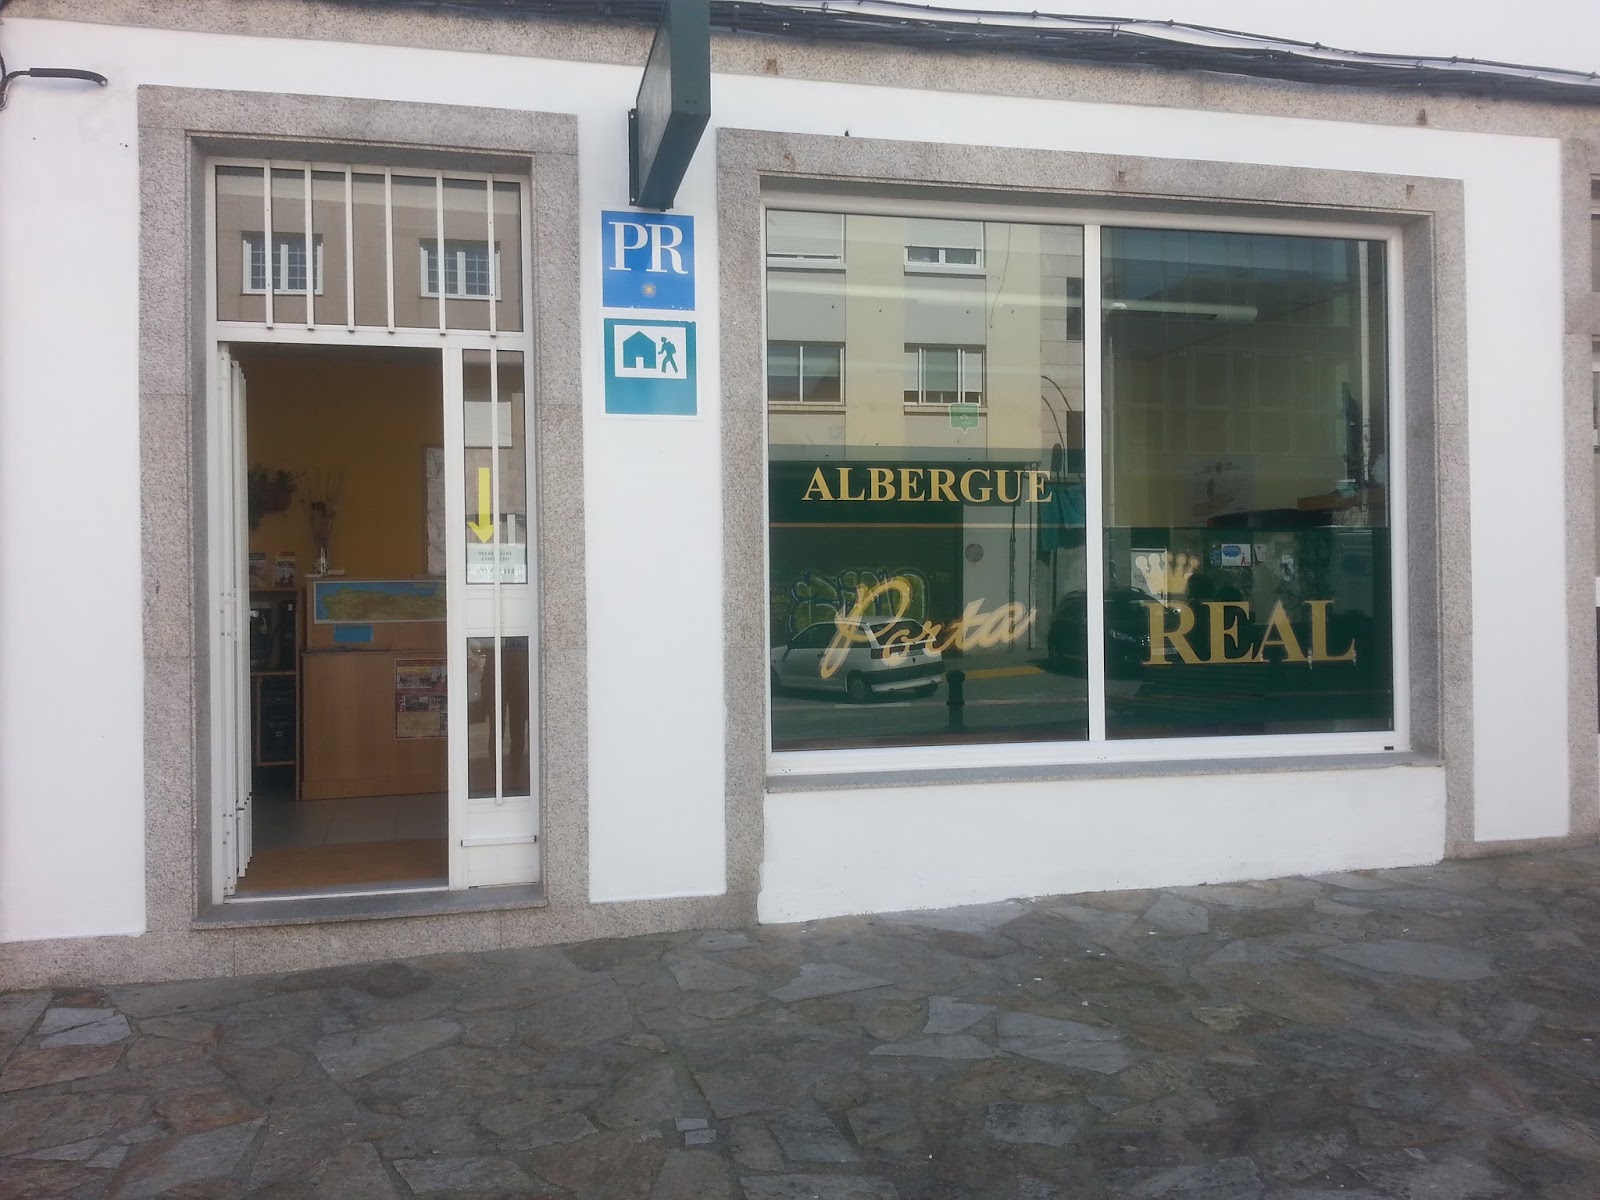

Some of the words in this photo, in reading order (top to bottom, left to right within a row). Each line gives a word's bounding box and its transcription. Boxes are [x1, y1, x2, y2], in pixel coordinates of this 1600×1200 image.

[608, 221, 689, 274] PR
[801, 466, 1053, 503] ALBERGUE
[820, 574, 1037, 679] Porta
[1143, 599, 1357, 665] REAL
